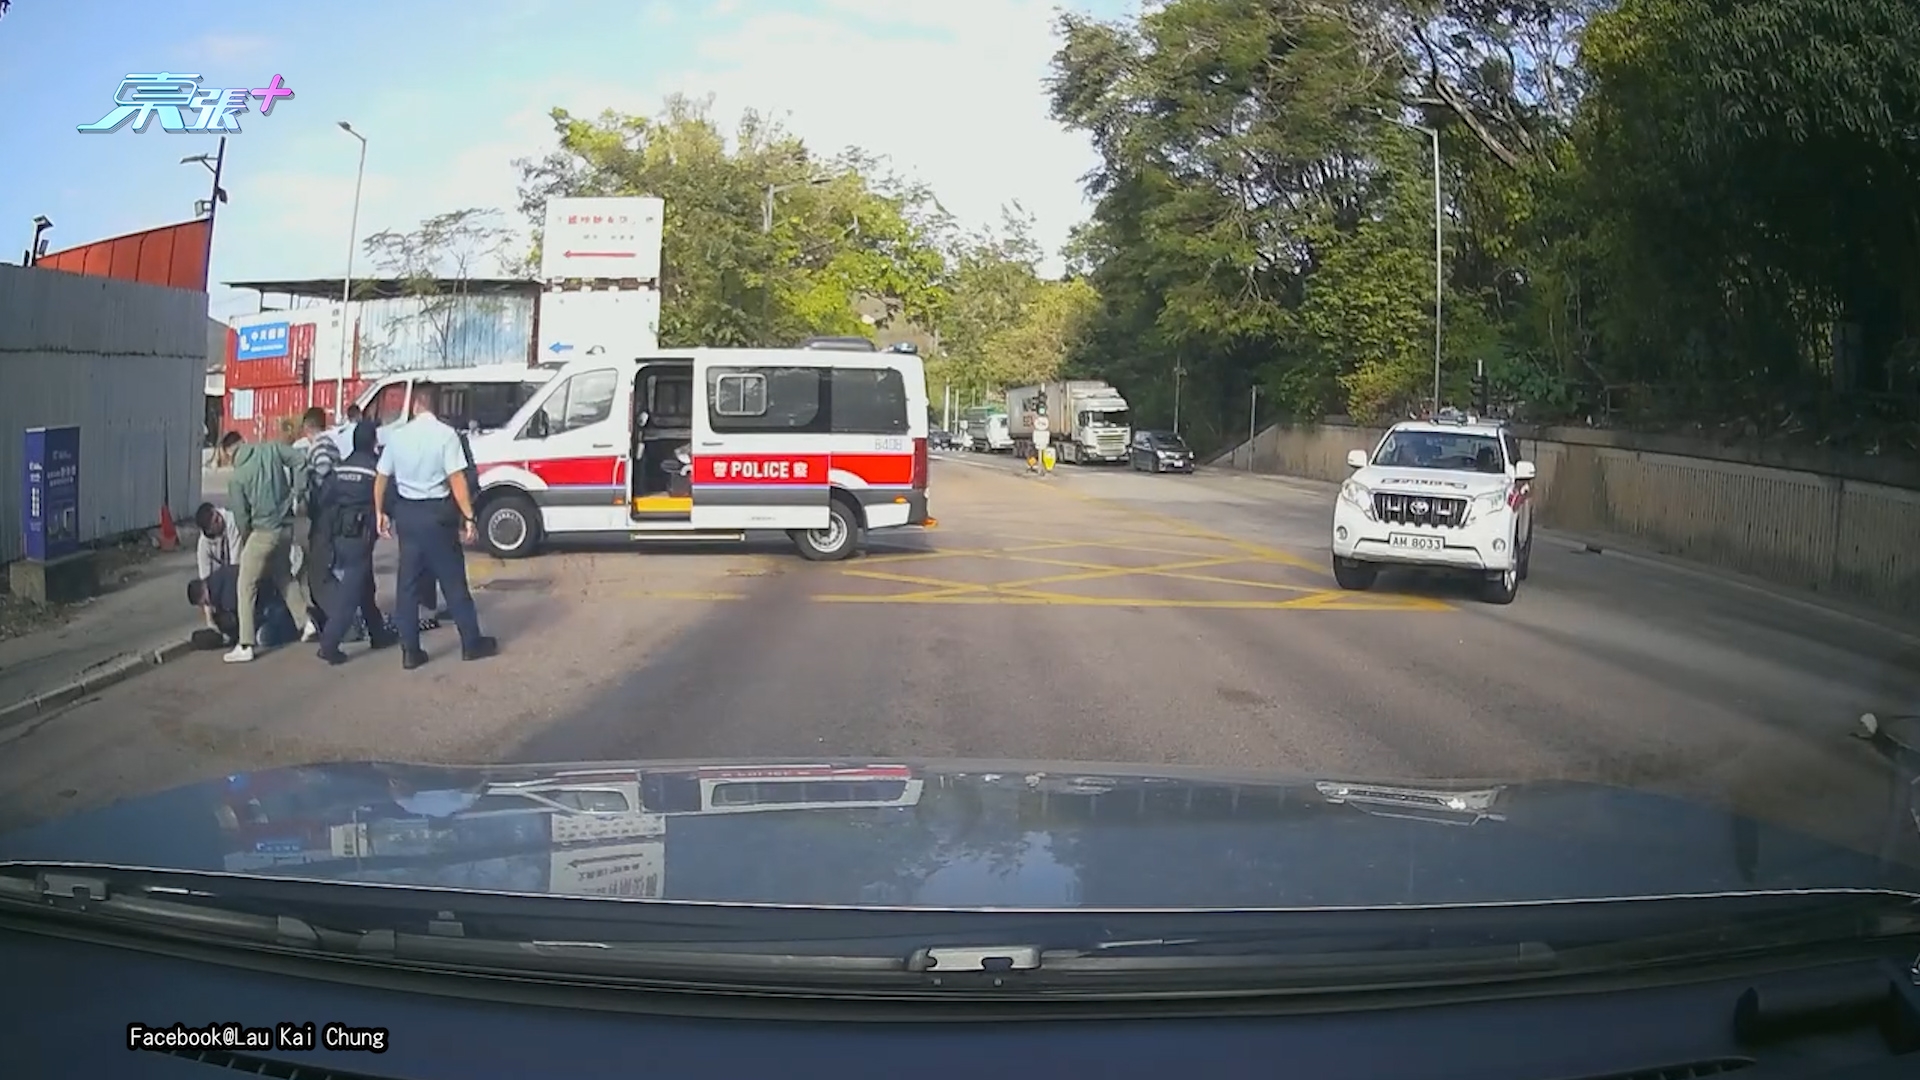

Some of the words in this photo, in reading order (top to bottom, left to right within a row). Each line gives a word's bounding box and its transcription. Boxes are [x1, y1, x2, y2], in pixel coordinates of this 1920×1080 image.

[731, 461, 789, 478] POLICE
[1393, 536, 1408, 547] AM
[1411, 537, 1441, 549] 8033
